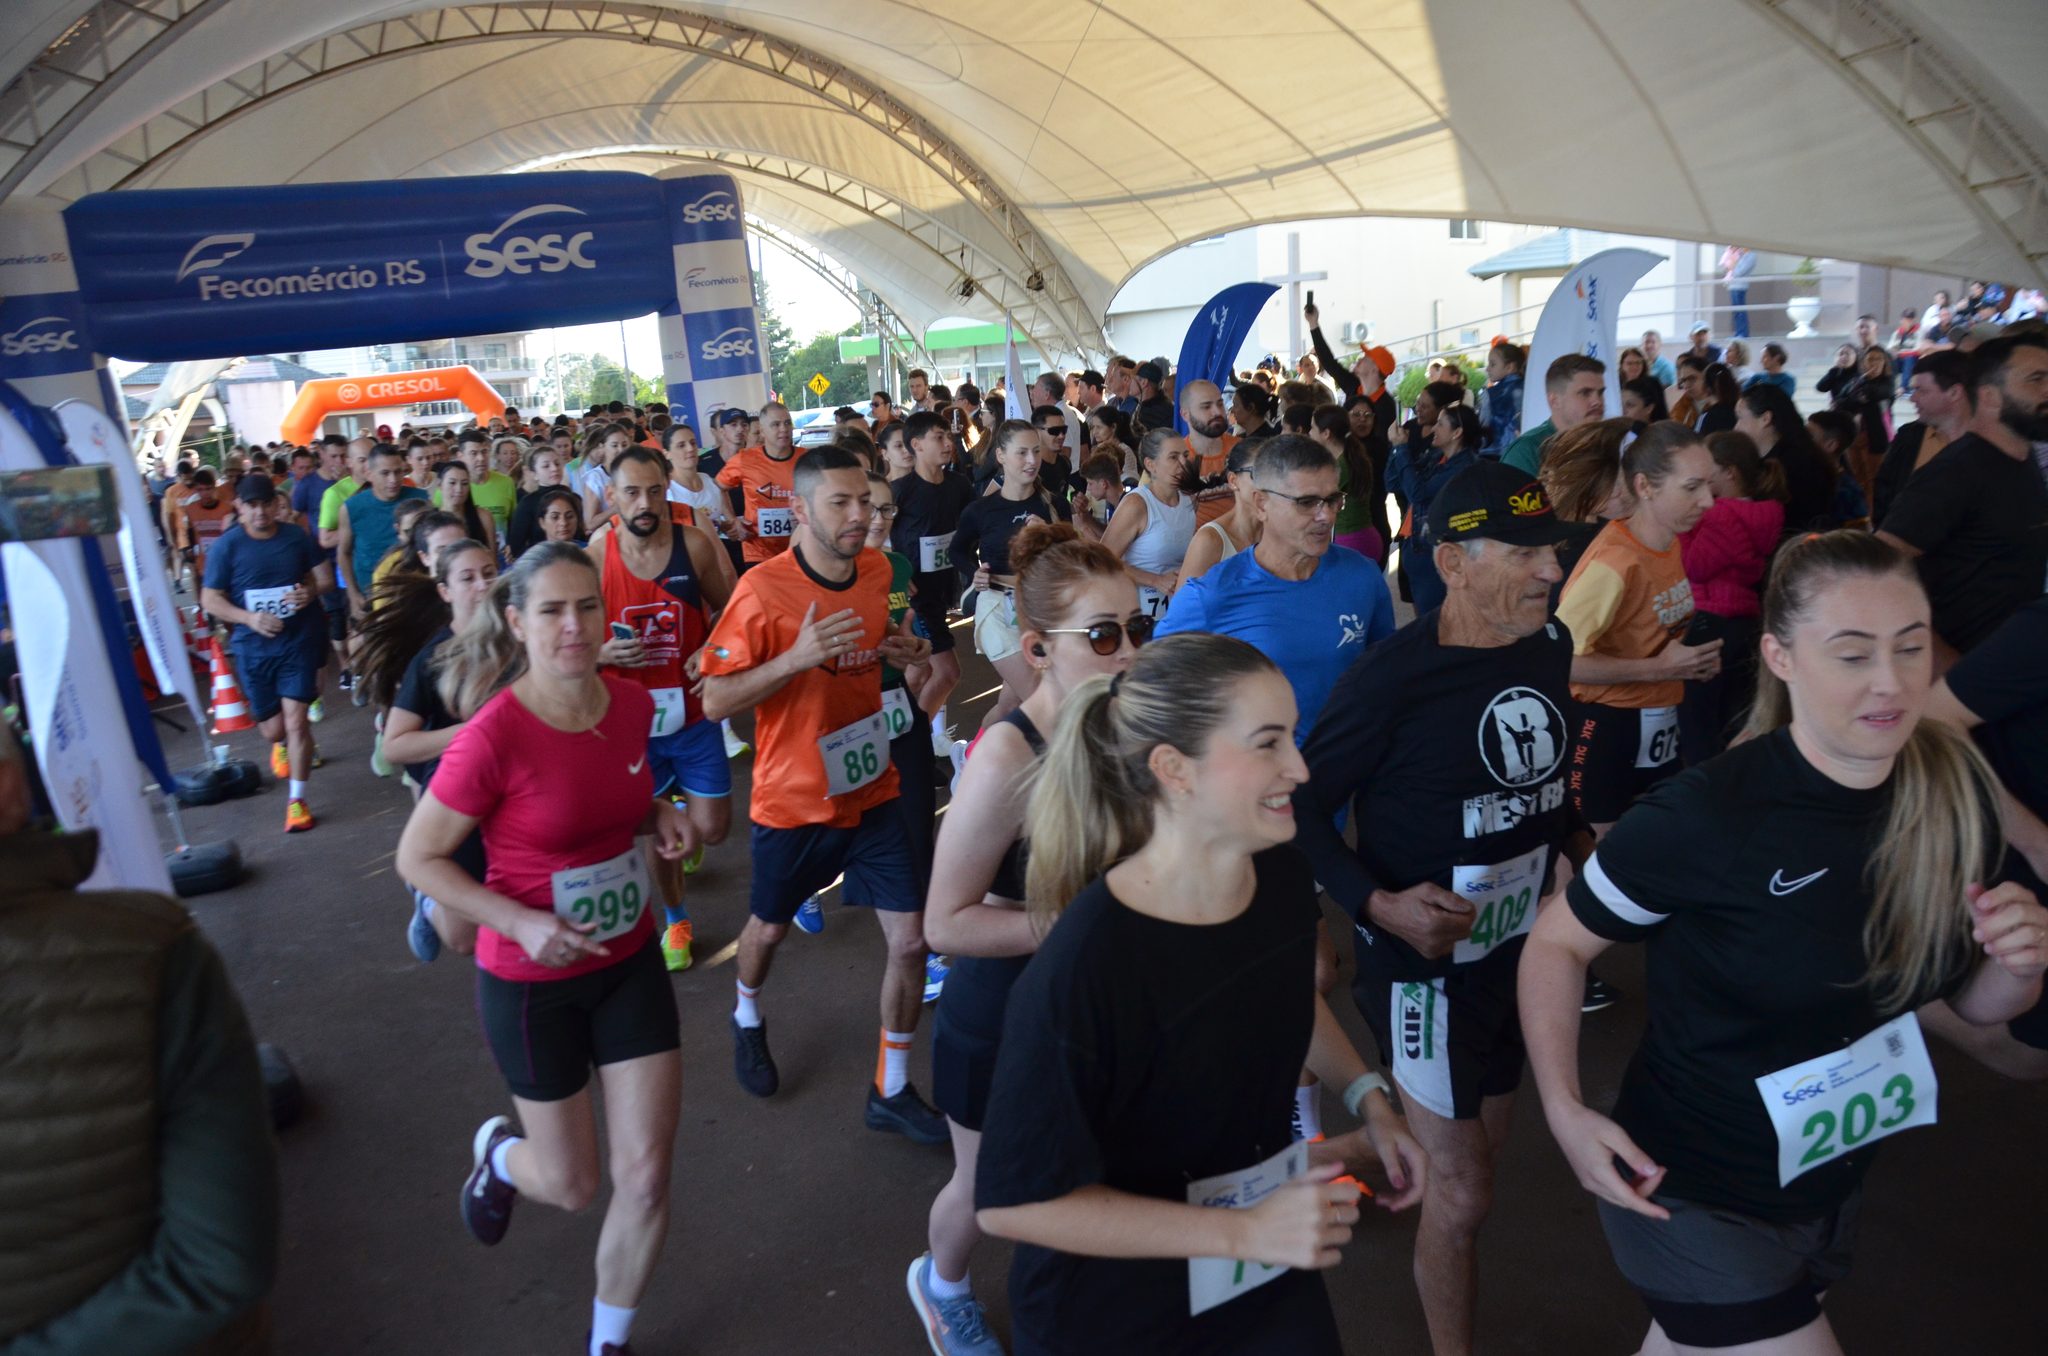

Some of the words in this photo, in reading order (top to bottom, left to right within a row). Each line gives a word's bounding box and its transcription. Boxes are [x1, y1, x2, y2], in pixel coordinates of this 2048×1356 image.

[198, 265, 378, 300] Fecomércio
[384, 259, 426, 287] RS
[688, 274, 739, 288] Fecomércio
[366, 377, 447, 398] CRESOL
[763, 518, 793, 535] 584
[843, 741, 878, 784] 86
[1648, 724, 1680, 763] 67
[571, 880, 640, 937] 299
[1469, 886, 1532, 950] 409
[1797, 1073, 1916, 1169] 203
